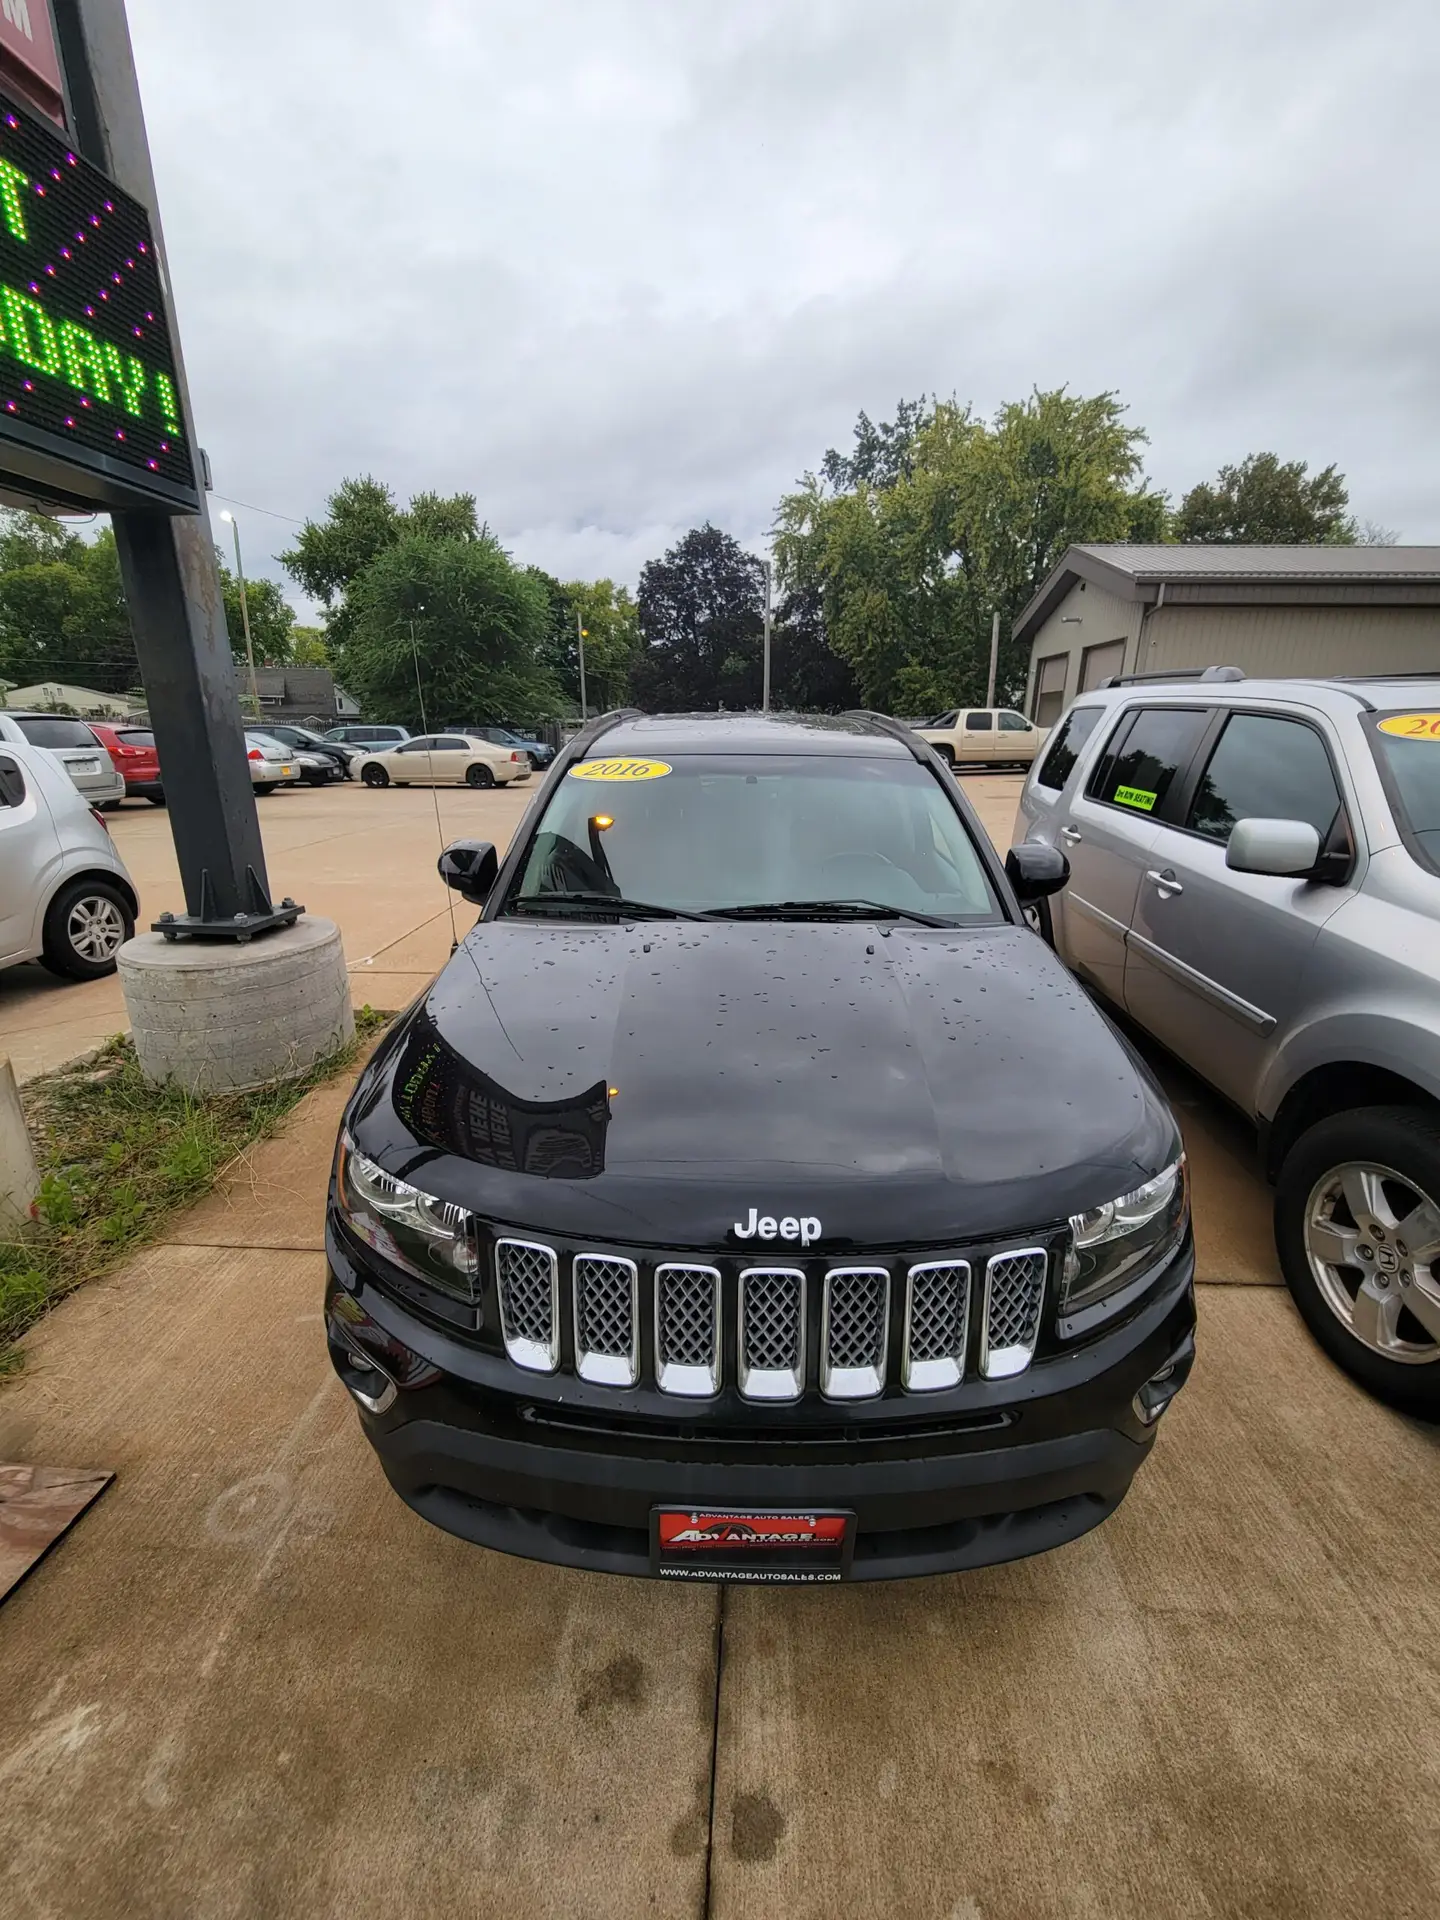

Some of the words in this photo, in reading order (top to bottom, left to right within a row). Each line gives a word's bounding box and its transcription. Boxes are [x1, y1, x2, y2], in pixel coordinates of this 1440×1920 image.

[0, 284, 181, 437] DAY!
[583, 763, 656, 776] 2016
[1133, 793, 1155, 806] SEATING
[734, 1208, 822, 1247] Jeep
[669, 1529, 814, 1542] ADVANTAGE
[660, 1568, 842, 1581] WWW.ADVANTAGEAUTOSALES.COM
